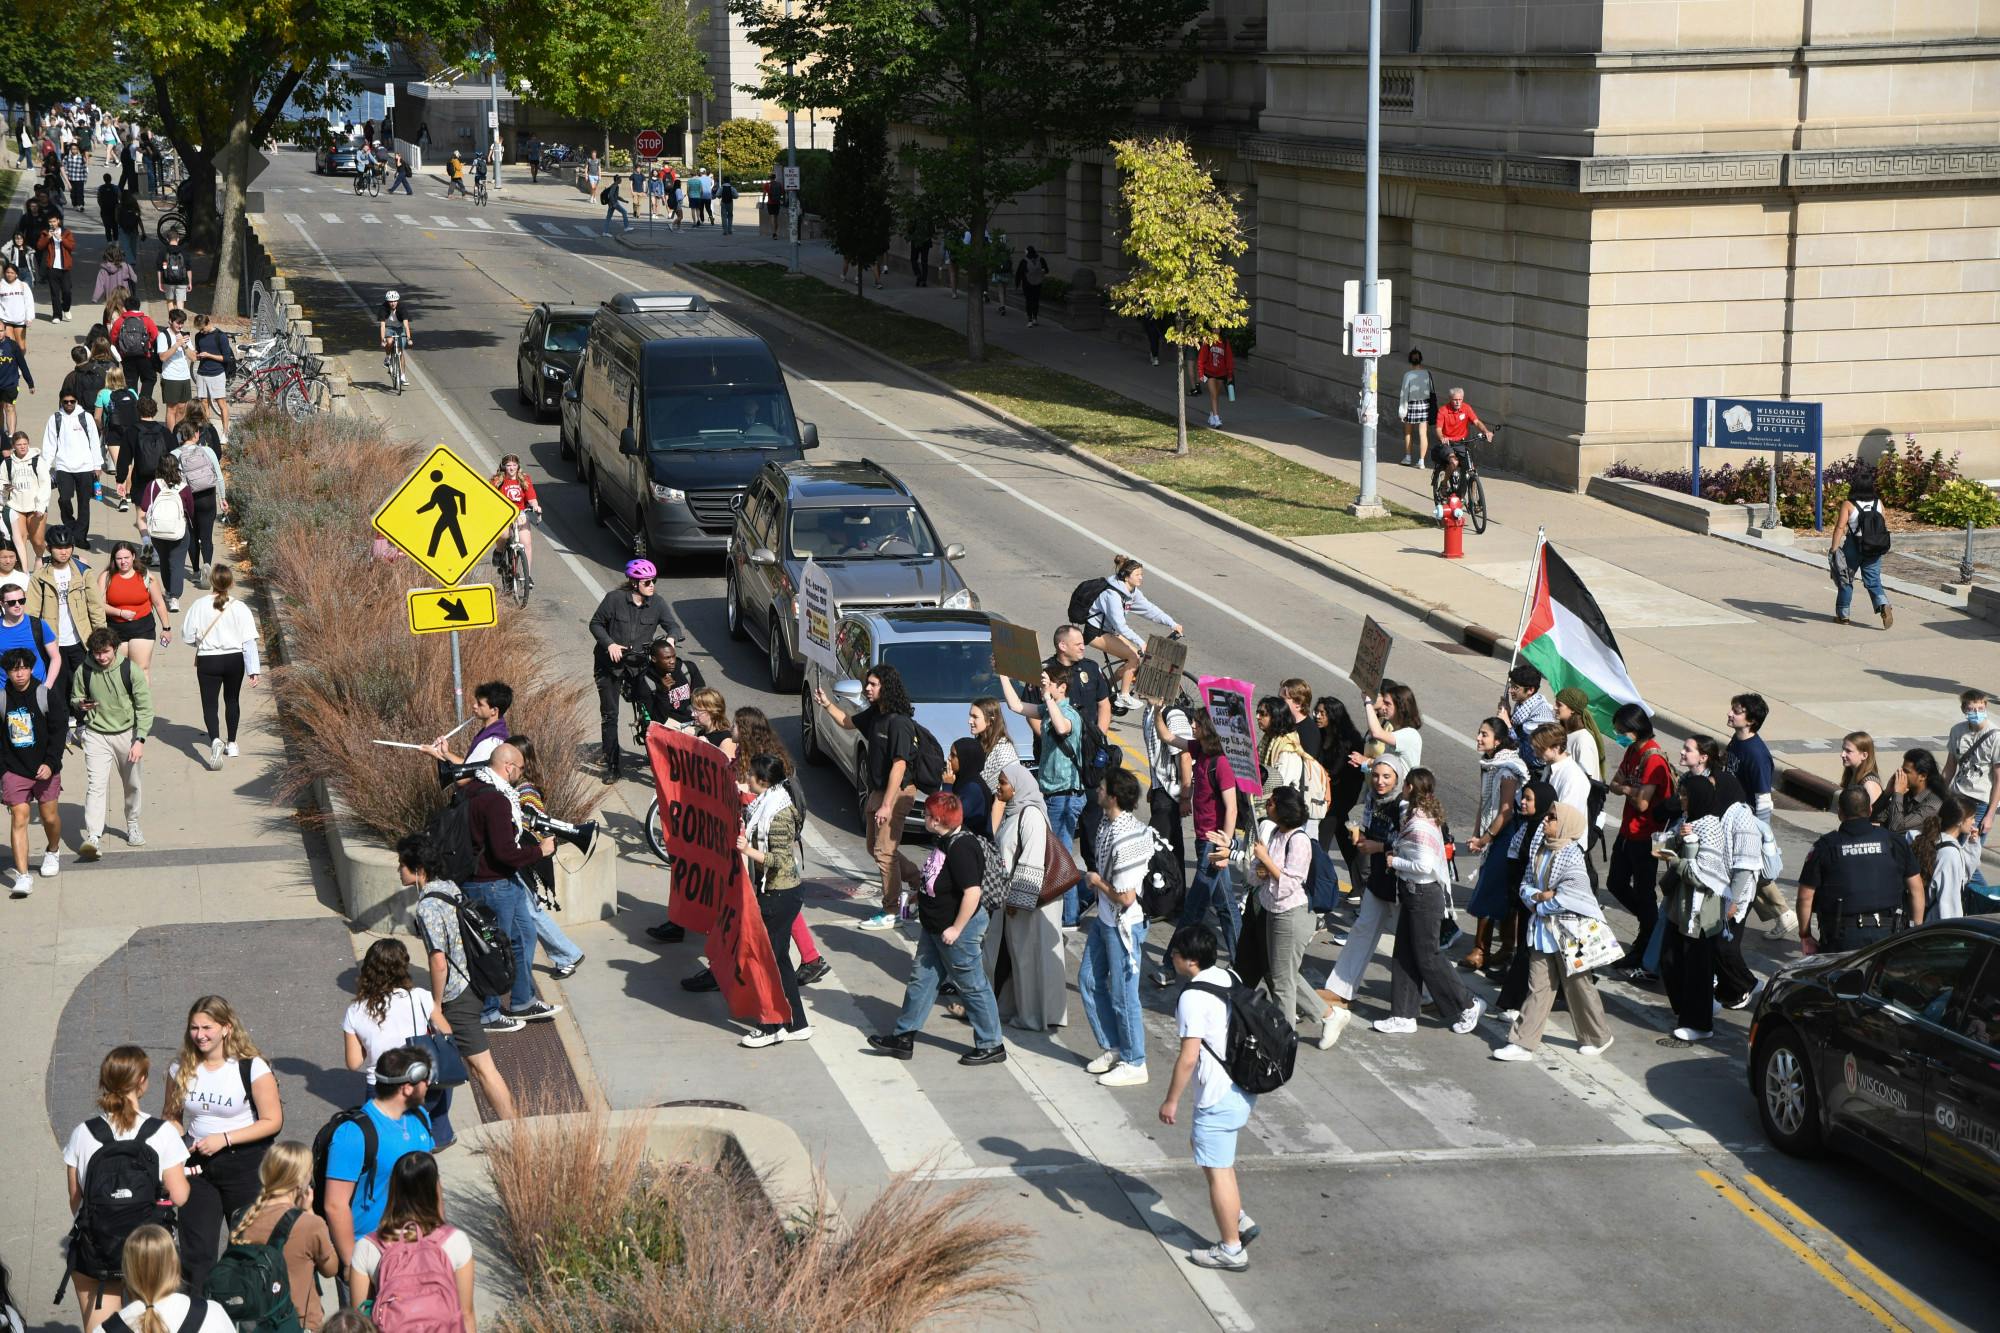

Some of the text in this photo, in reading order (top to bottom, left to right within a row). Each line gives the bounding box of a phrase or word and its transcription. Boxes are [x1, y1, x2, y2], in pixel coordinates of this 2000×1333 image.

[638, 138, 661, 149] STOP
[1362, 318, 1373, 327] NO
[1355, 327, 1380, 335] PARKING
[1756, 407, 1806, 416] WISCONSIN
[1756, 416, 1806, 425] HISTORICAL
[1756, 425, 1806, 434] SOCIETY
[667, 745, 718, 800] DIVEST
[1842, 846, 1883, 856] POLICE
[1857, 1072, 1908, 1109] WISCONSIN
[1935, 1104, 1956, 1131] GO
